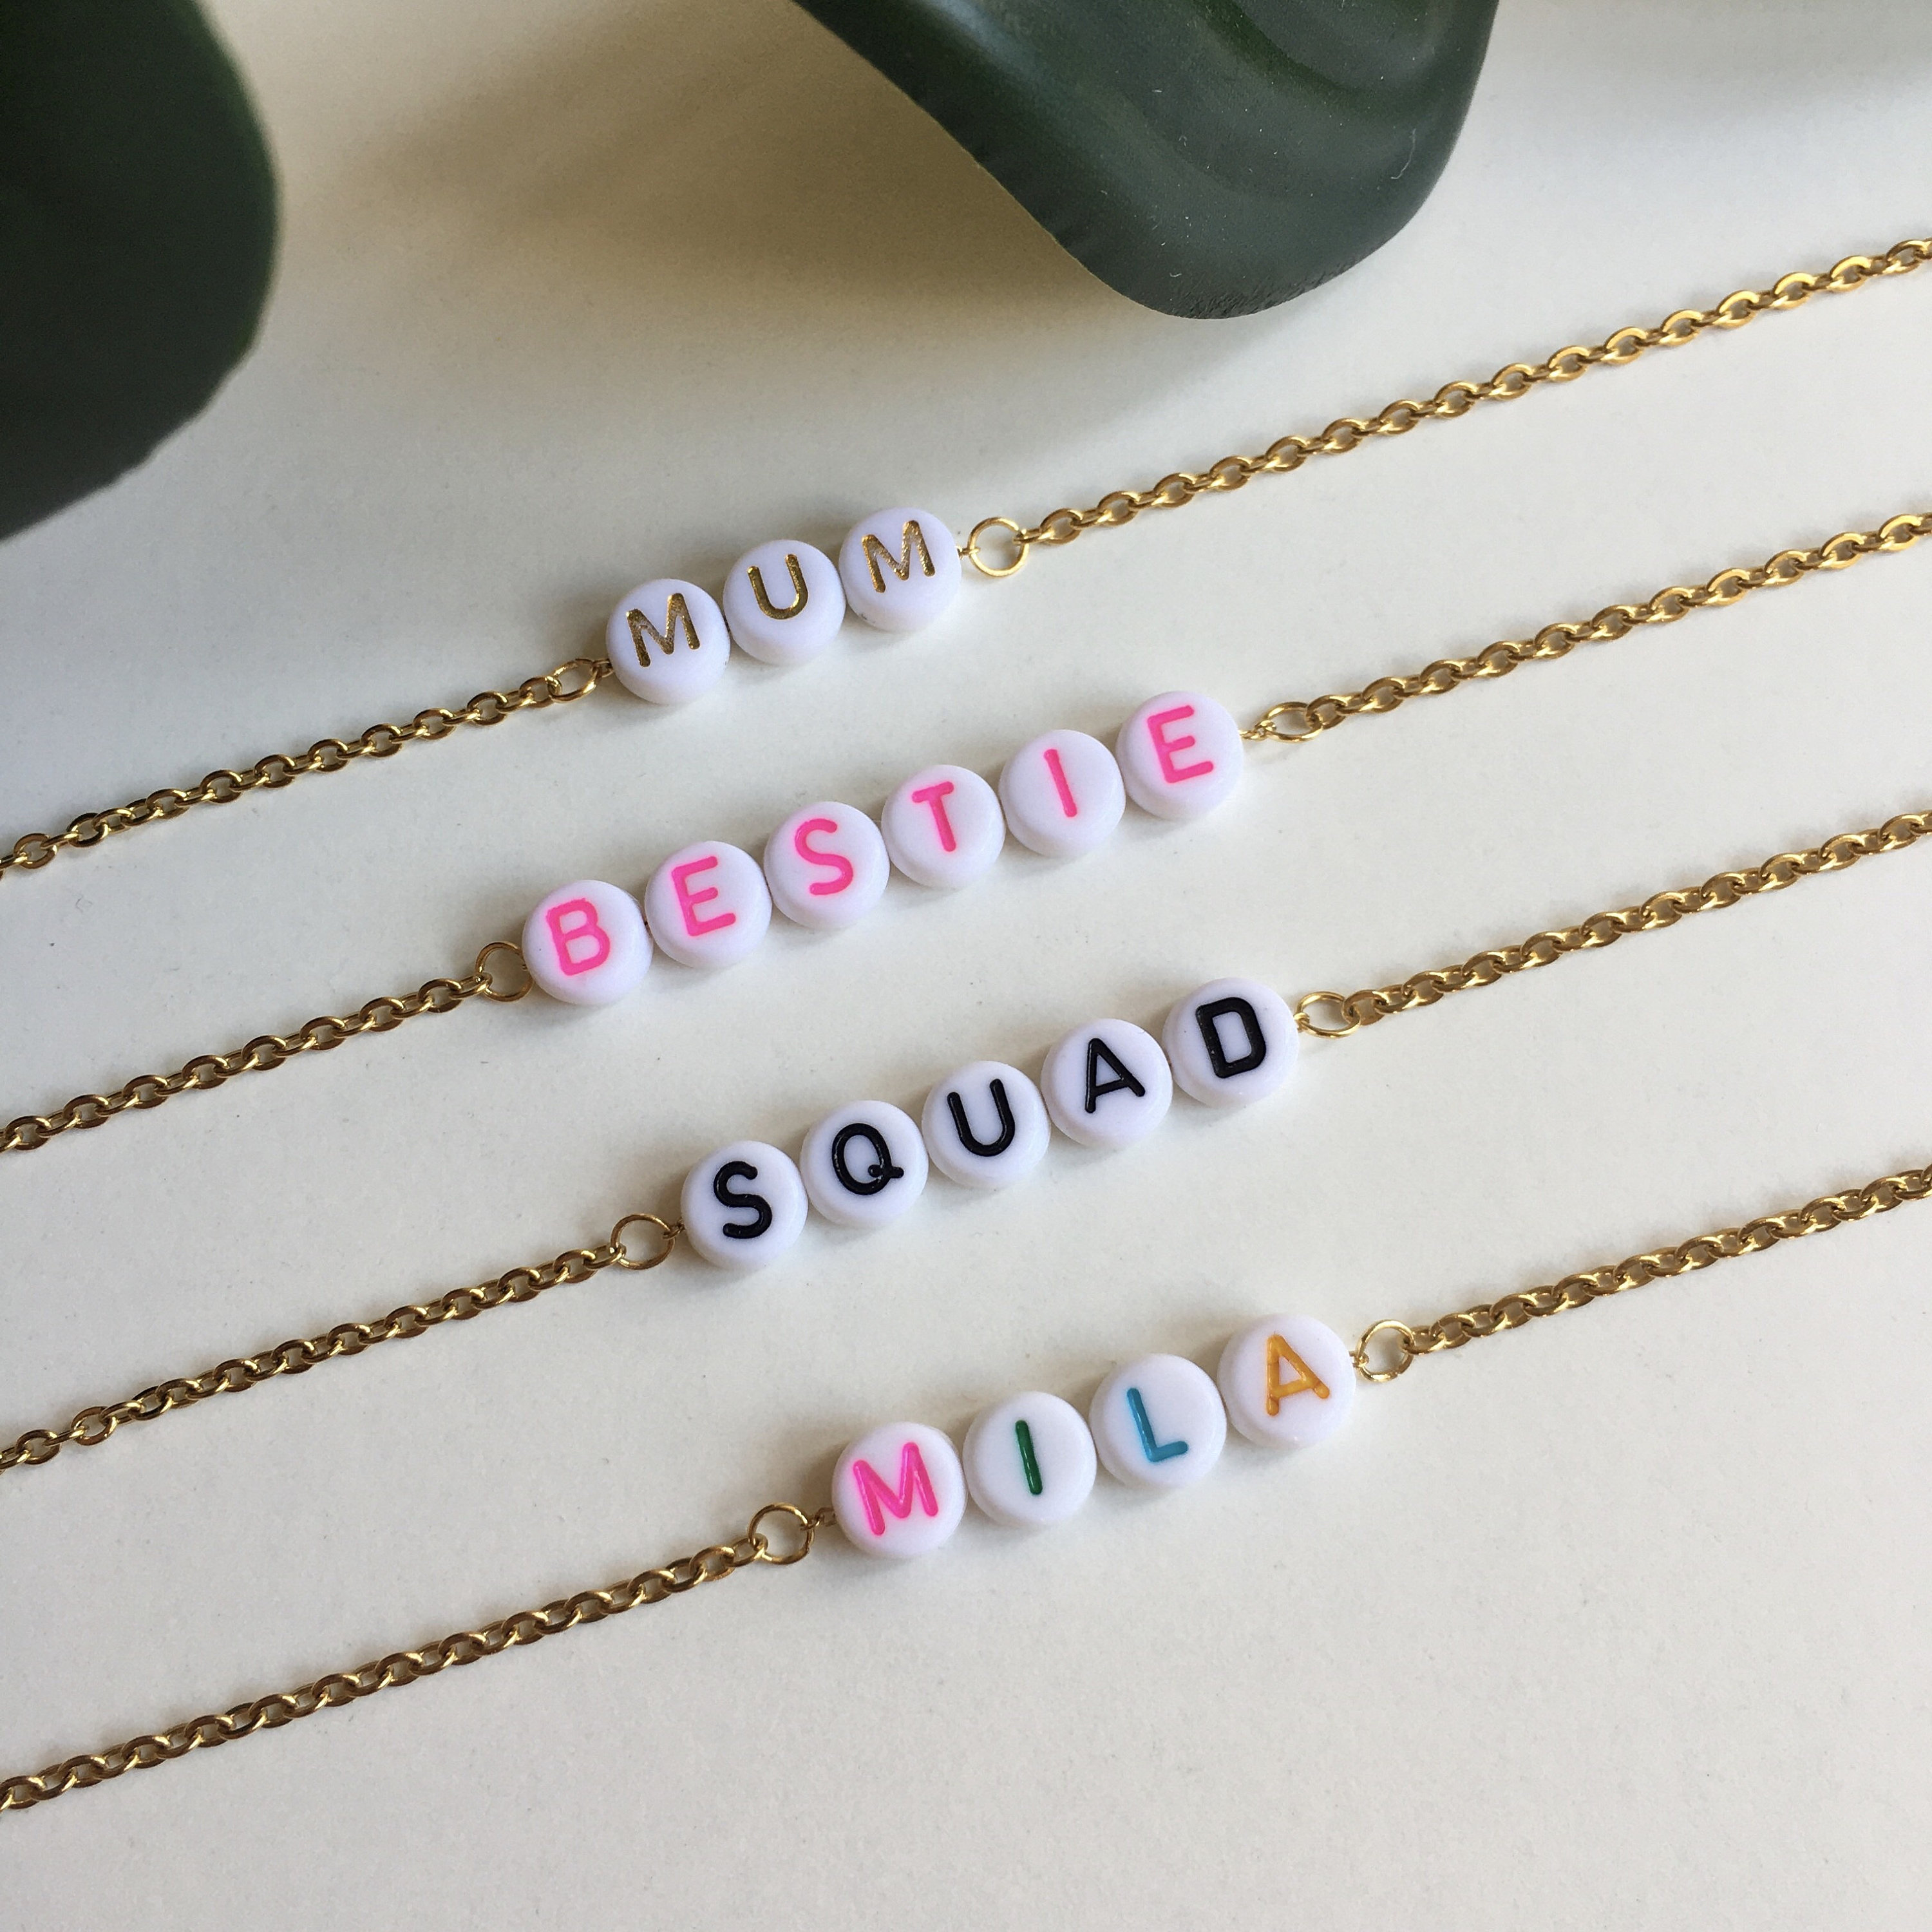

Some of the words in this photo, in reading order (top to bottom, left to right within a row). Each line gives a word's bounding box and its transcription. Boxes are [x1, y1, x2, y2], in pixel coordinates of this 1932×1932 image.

[627, 520, 936, 668] MUM
[547, 706, 1215, 976] BESTIE
[712, 996, 1267, 1240] SQUAD
[853, 1333, 1331, 1536] MILA
